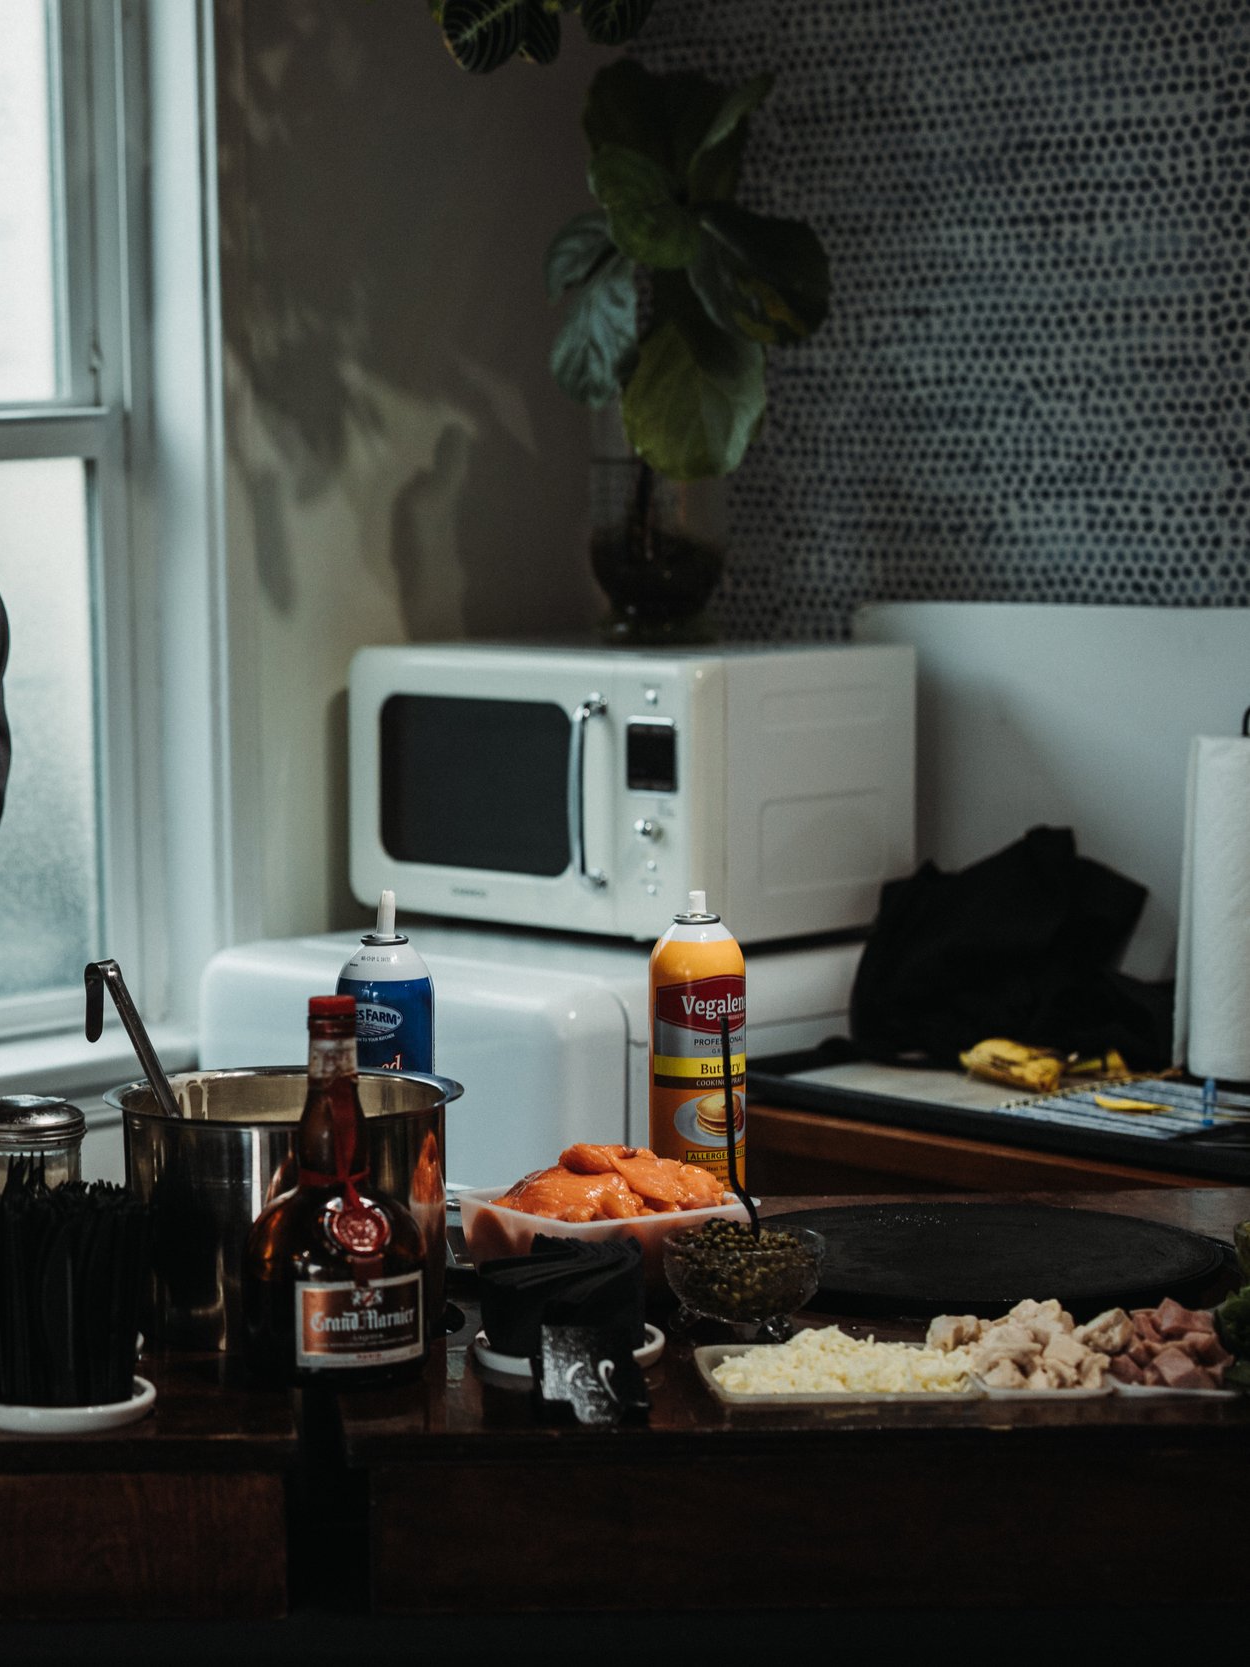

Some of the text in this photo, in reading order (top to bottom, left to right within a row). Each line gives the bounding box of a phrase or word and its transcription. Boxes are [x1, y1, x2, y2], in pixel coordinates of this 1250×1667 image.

[366, 1008, 397, 1025] FARM
[694, 1036, 743, 1046] PROFESONAL
[701, 1062, 741, 1075] Butry
[696, 1079, 725, 1087] COOKIN
[690, 1151, 729, 1160] ALLERGE
[310, 1311, 359, 1333] Grand
